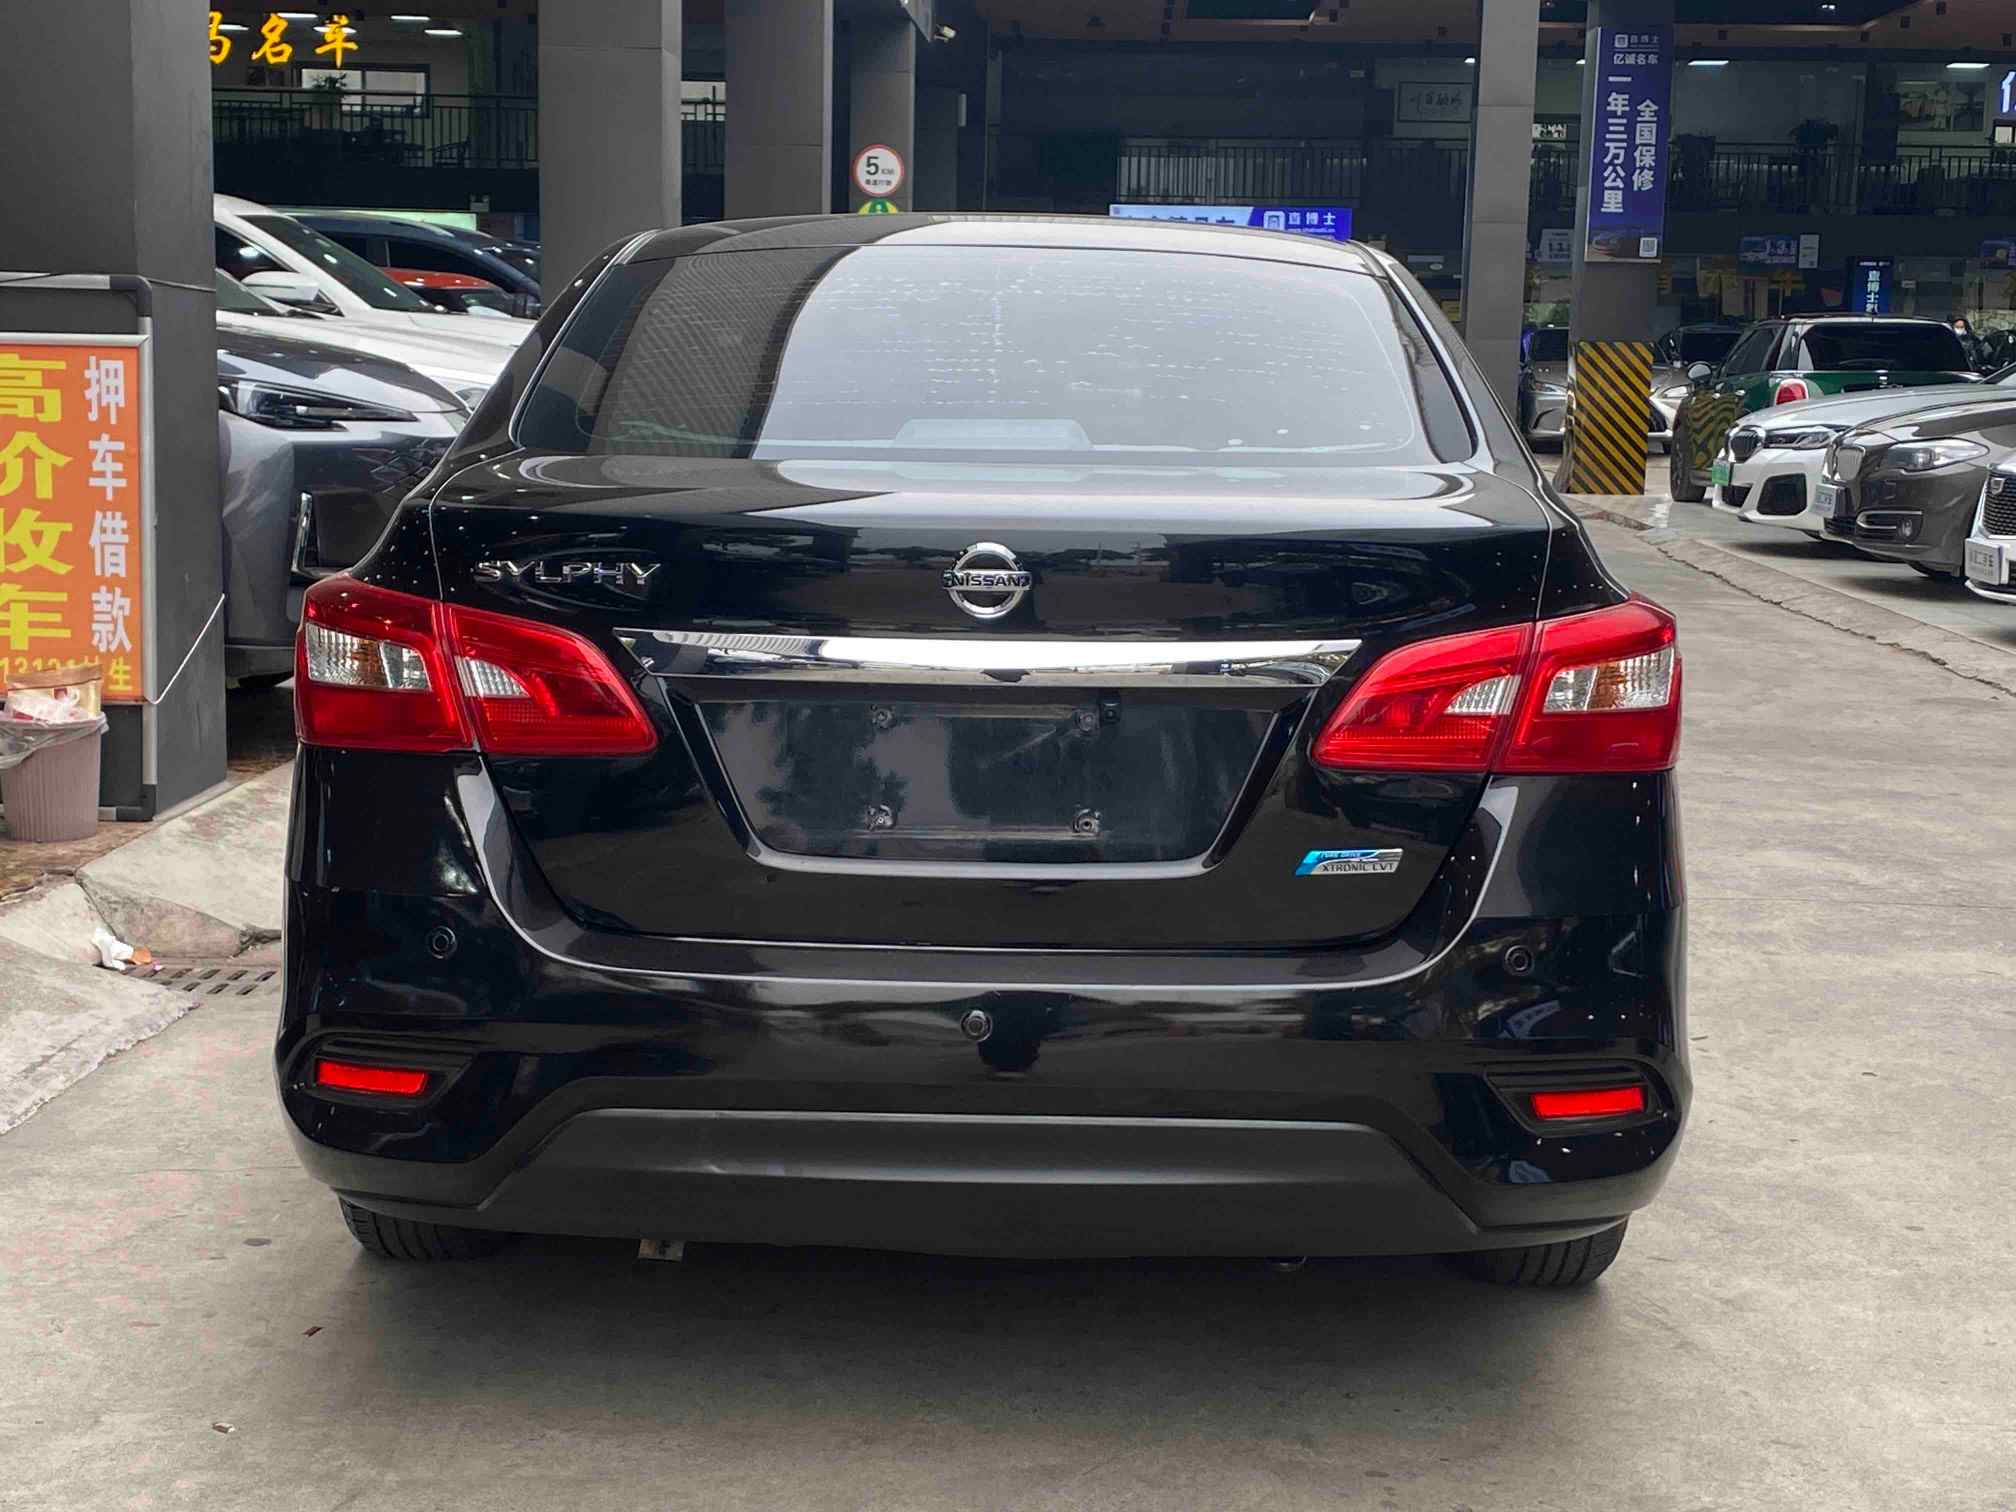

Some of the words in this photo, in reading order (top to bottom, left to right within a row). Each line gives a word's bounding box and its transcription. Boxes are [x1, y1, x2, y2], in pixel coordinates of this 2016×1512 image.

[1600, 76, 1632, 213] 一年三万公里
[1632, 99, 1659, 192] 全国保修
[865, 155, 880, 176] 5
[84, 355, 133, 653] 押车借款
[474, 560, 662, 585] SYLPHY
[952, 572, 1022, 588] NISSAN
[1322, 862, 1370, 873] XTRONIC
[1372, 862, 1394, 872] CVT
